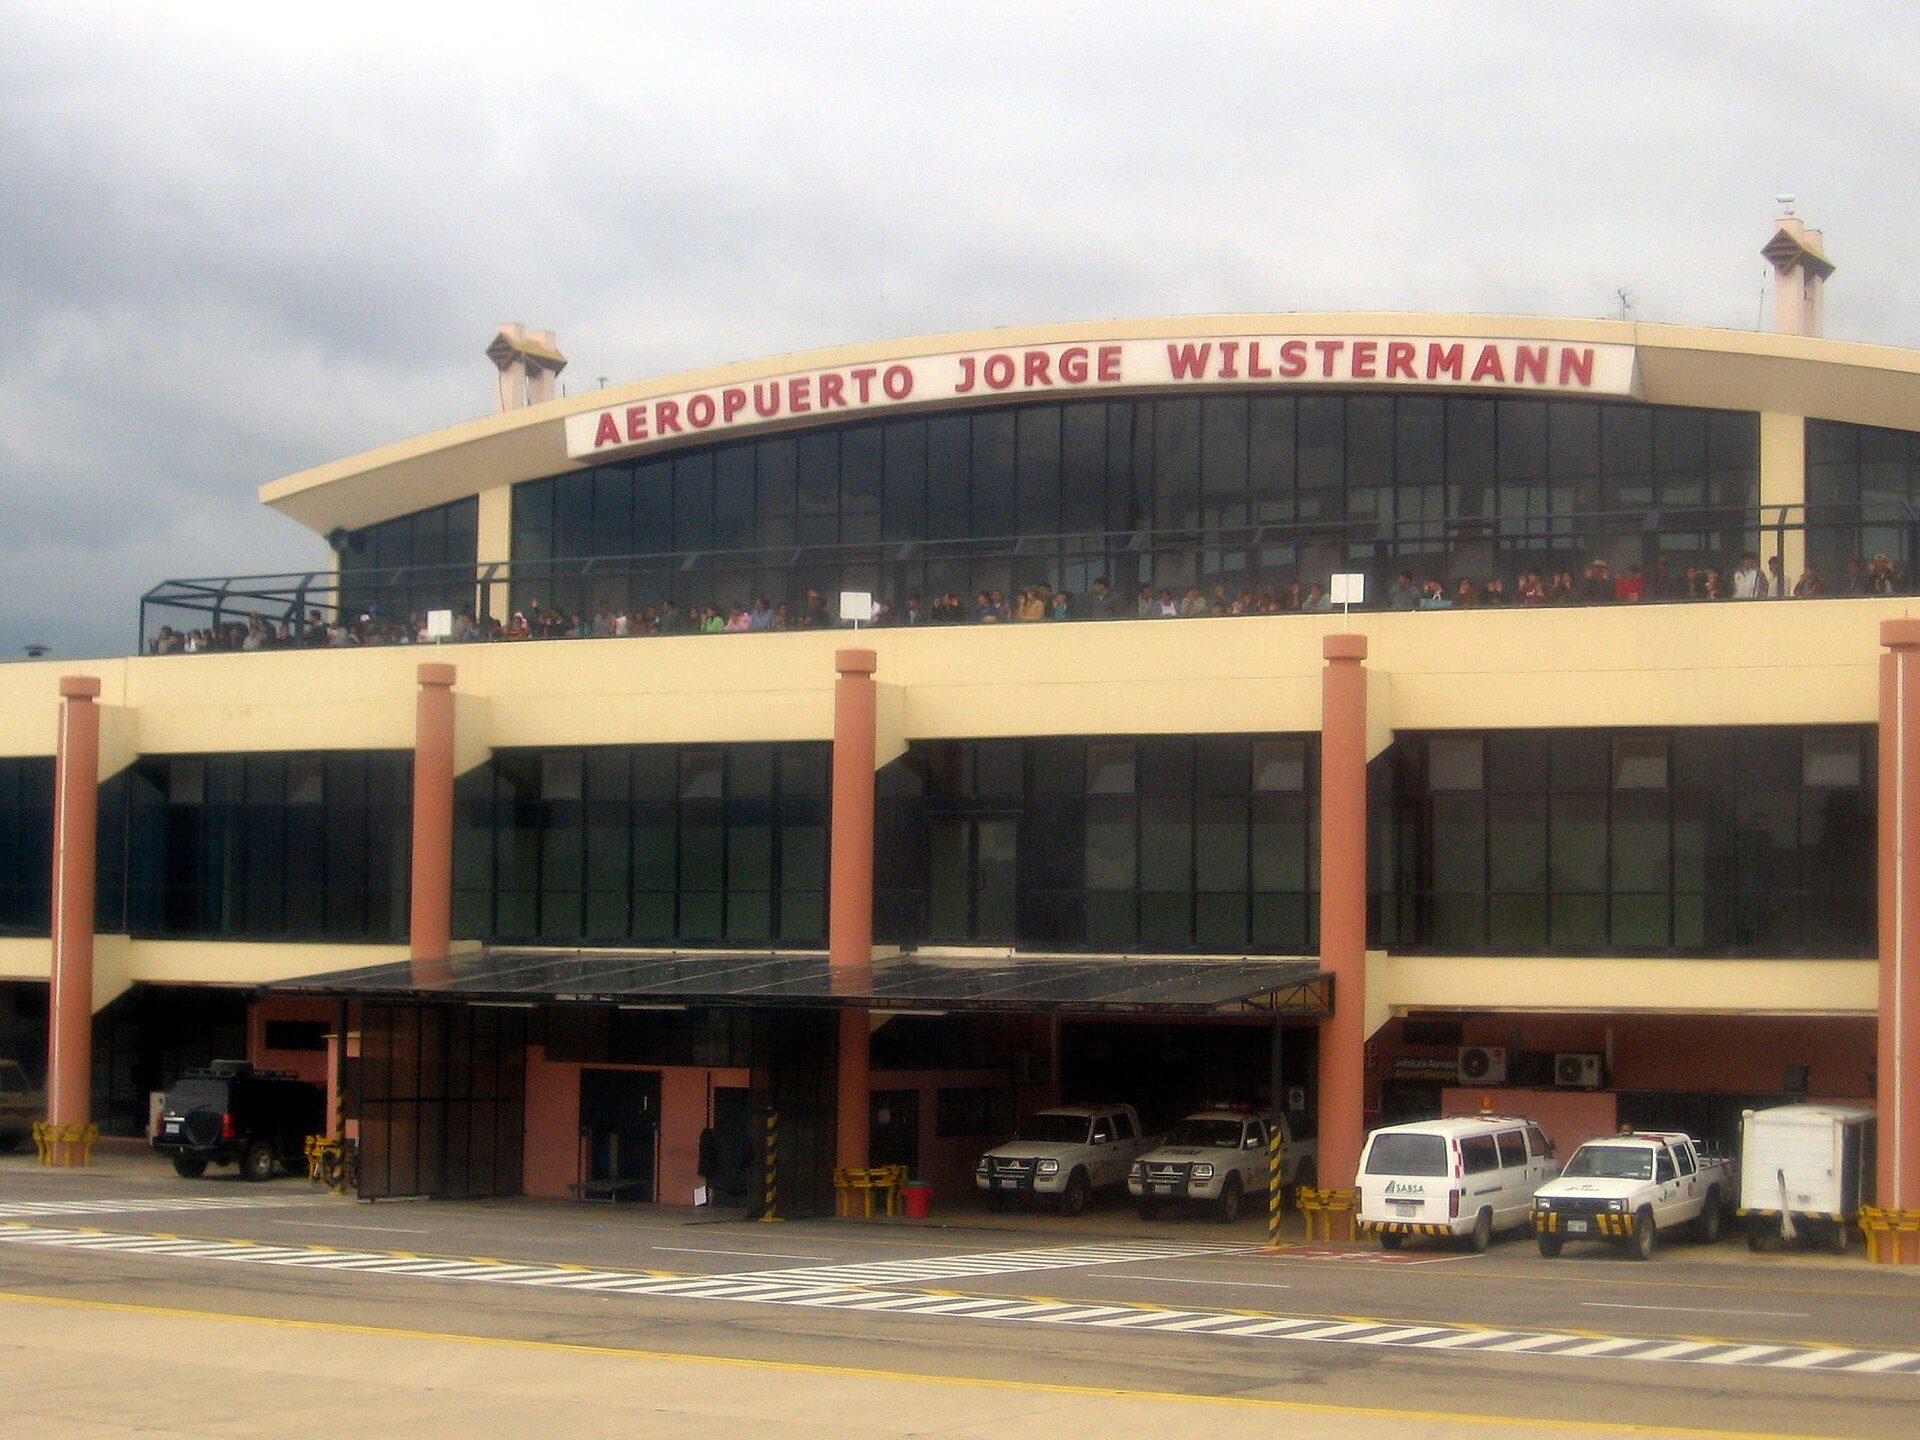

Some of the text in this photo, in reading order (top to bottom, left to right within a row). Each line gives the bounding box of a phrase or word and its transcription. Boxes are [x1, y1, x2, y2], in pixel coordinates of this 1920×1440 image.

[594, 340, 1594, 447] AEROPUERTO JORGE WILSTERMANN
[1396, 1183, 1424, 1193] SABSA
